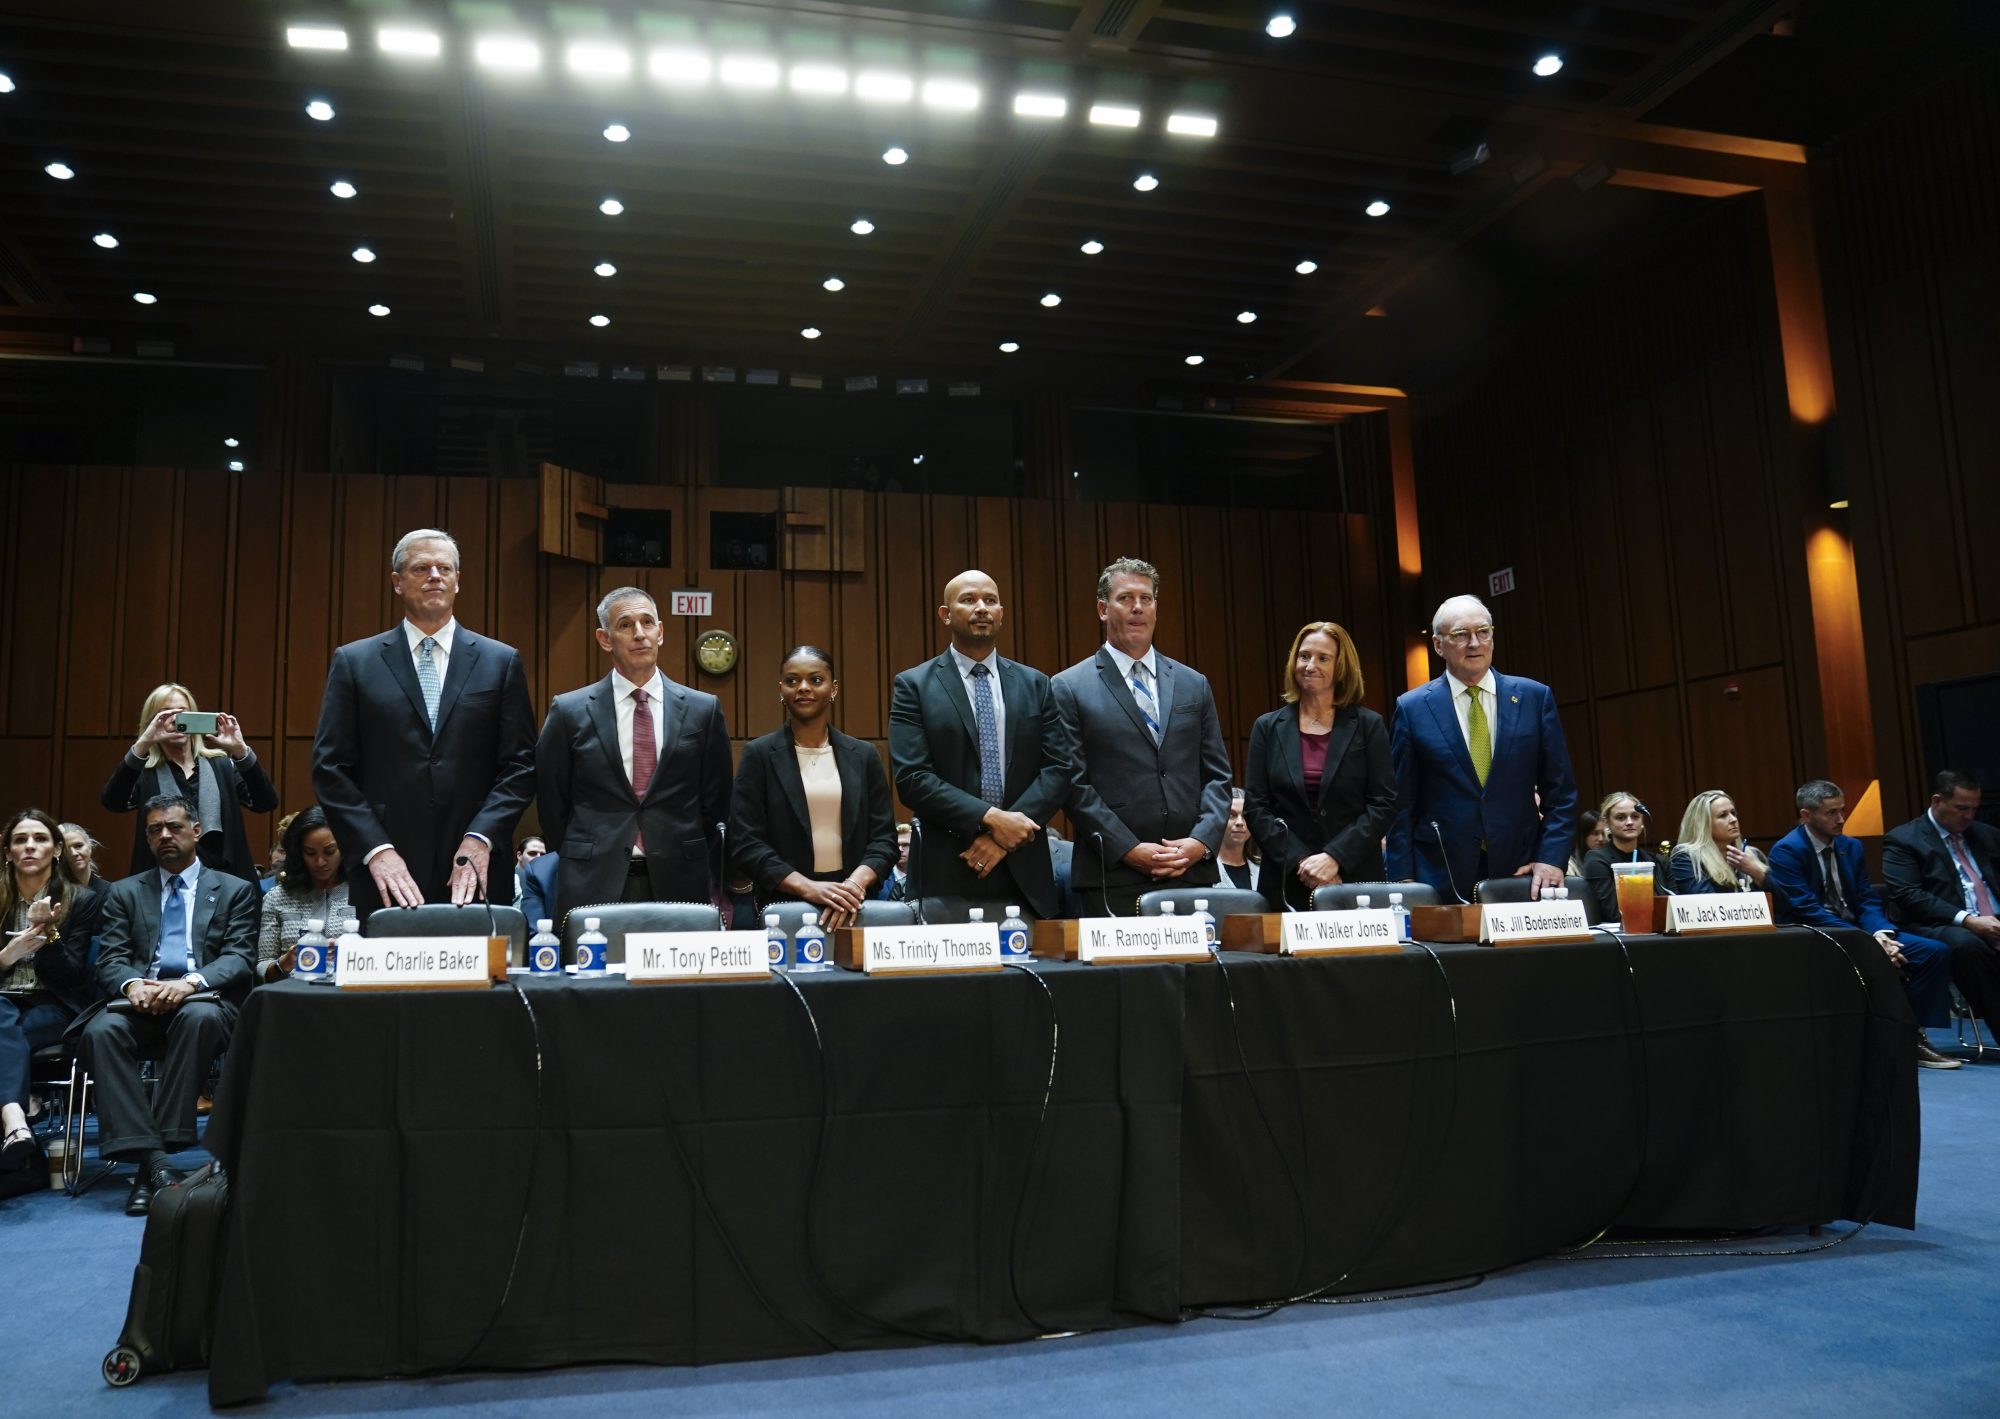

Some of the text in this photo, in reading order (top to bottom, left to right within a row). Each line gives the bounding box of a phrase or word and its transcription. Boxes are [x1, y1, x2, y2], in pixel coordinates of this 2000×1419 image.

[677, 596, 707, 614] EXIT
[1491, 913, 1582, 933] Ms. Jill Bodensteiner
[1676, 903, 1766, 924] Mr. Jack Swarbrick
[1091, 929, 1110, 948] Mr.
[1115, 928, 1161, 950] Ramogi
[1165, 927, 1199, 945] Huma
[1295, 920, 1389, 941] Mr. Walker Jones
[346, 950, 479, 973] Hon. Charlie Baker
[642, 948, 665, 969] Mr.
[669, 947, 706, 974] Tony
[710, 946, 752, 967] Petitti
[873, 941, 895, 961] Ms.
[898, 939, 938, 963] Trinity
[942, 938, 992, 957] Thomas
